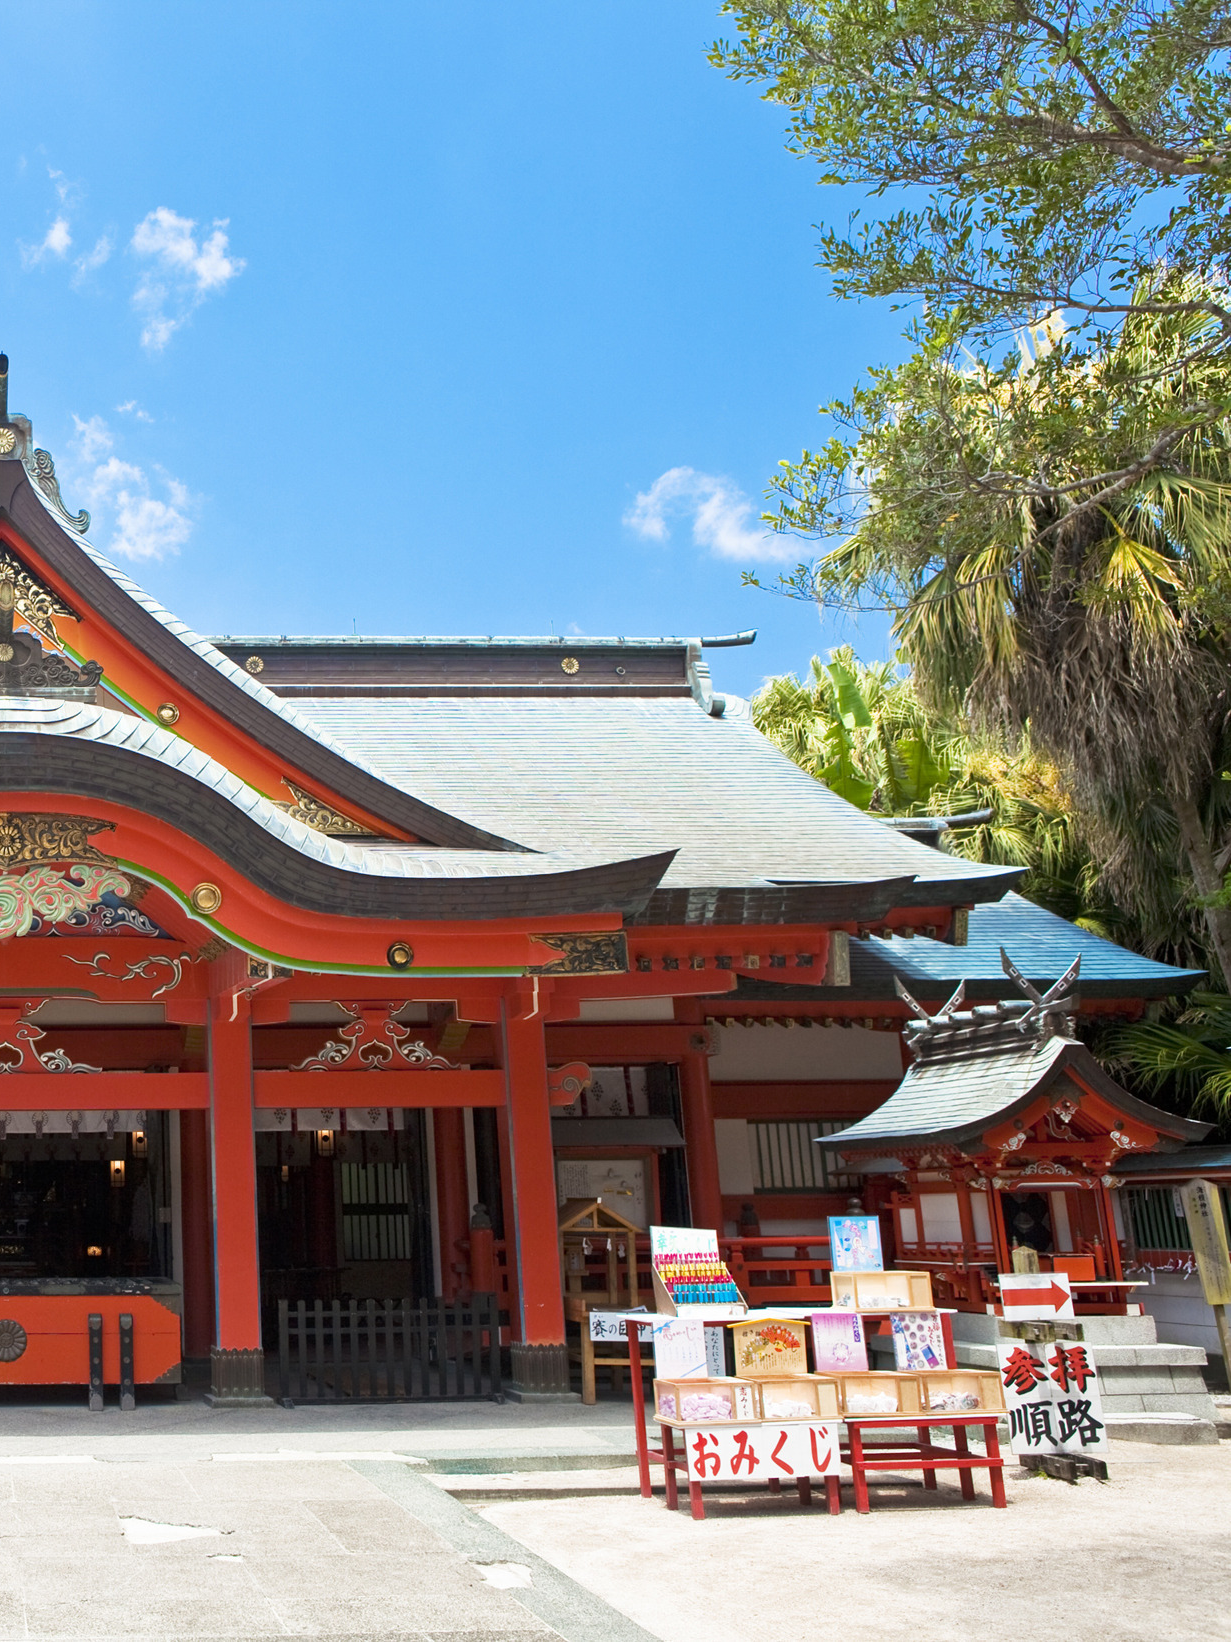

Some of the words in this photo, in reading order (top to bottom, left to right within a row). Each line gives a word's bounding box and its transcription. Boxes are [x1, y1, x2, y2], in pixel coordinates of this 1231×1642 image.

[710, 1327, 720, 1375] あなたにとって
[1001, 1345, 1096, 1395] 参拝
[1009, 1399, 1104, 1447] 順路
[692, 1426, 831, 1478] おみくじ
